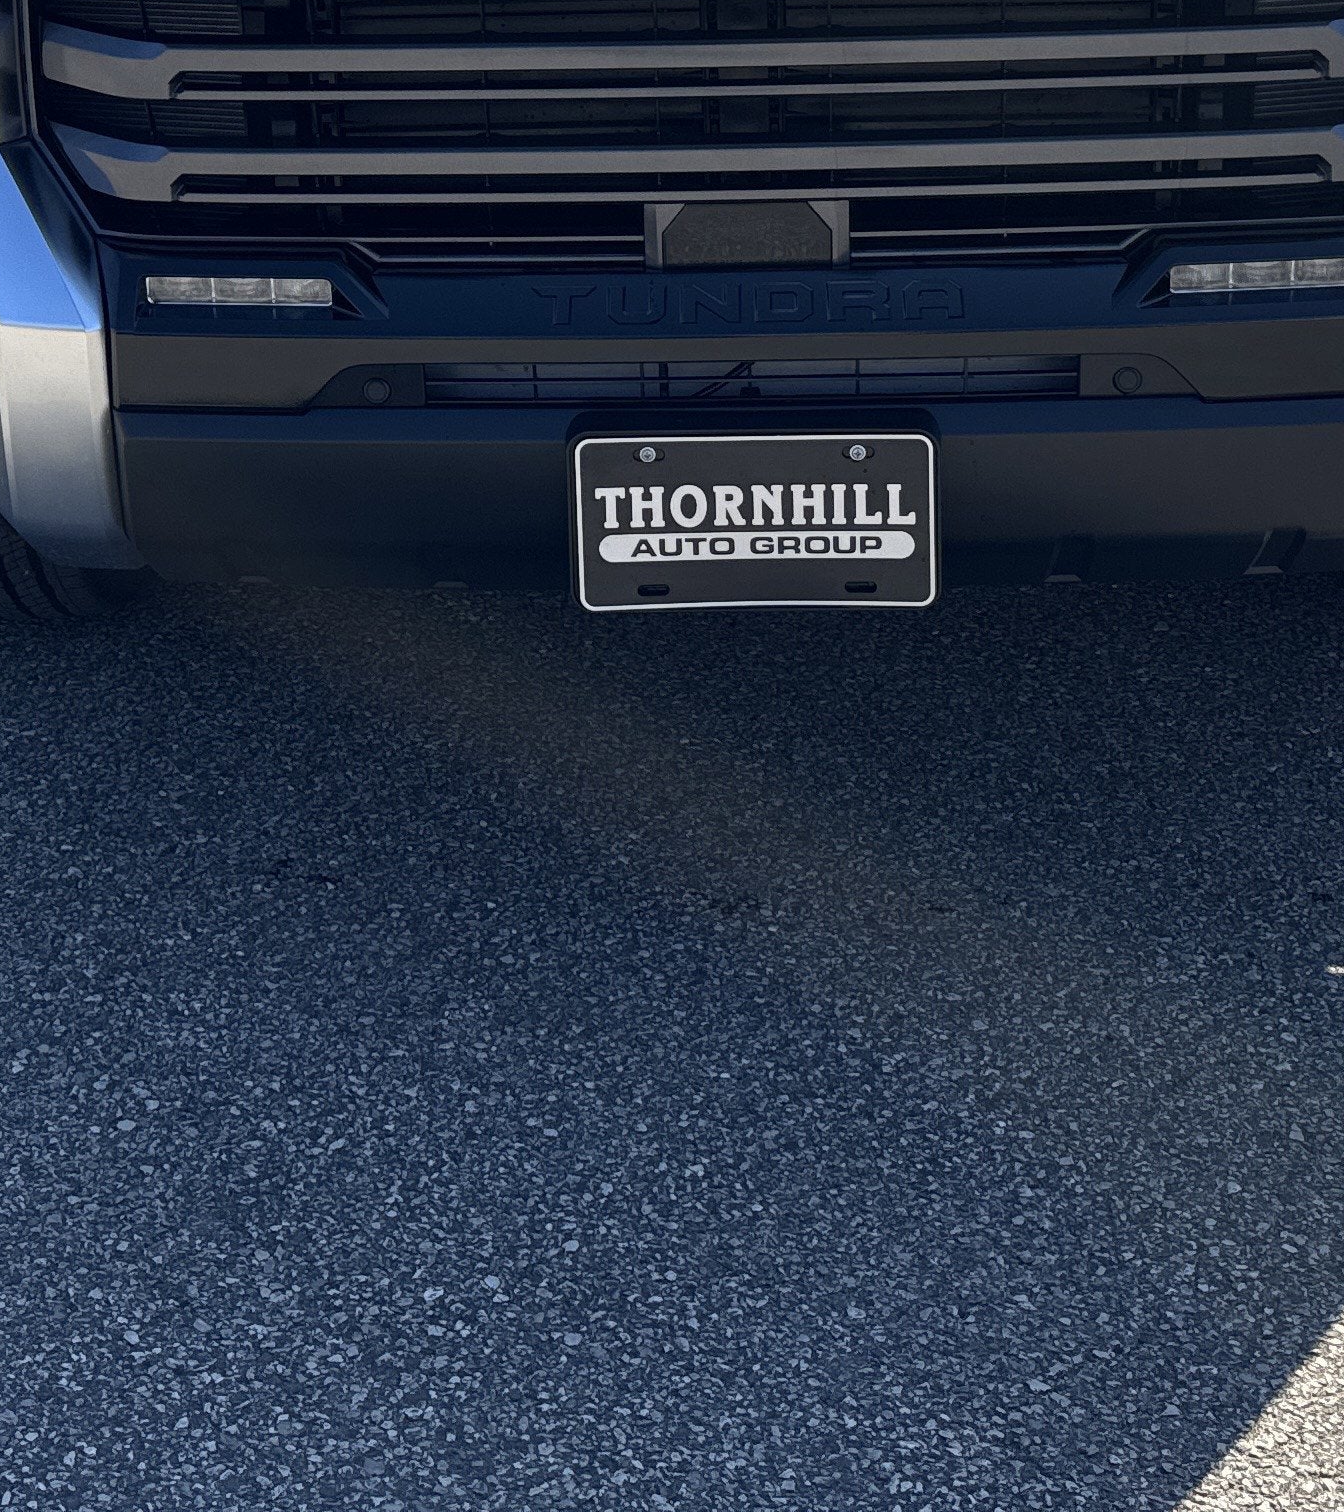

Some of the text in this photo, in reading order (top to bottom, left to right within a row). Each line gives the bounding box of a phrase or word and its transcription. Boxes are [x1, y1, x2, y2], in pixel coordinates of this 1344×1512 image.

[531, 279, 966, 326] TUNDRA
[594, 483, 917, 529] THORNHILL
[630, 535, 883, 558] AUTO GROUP
